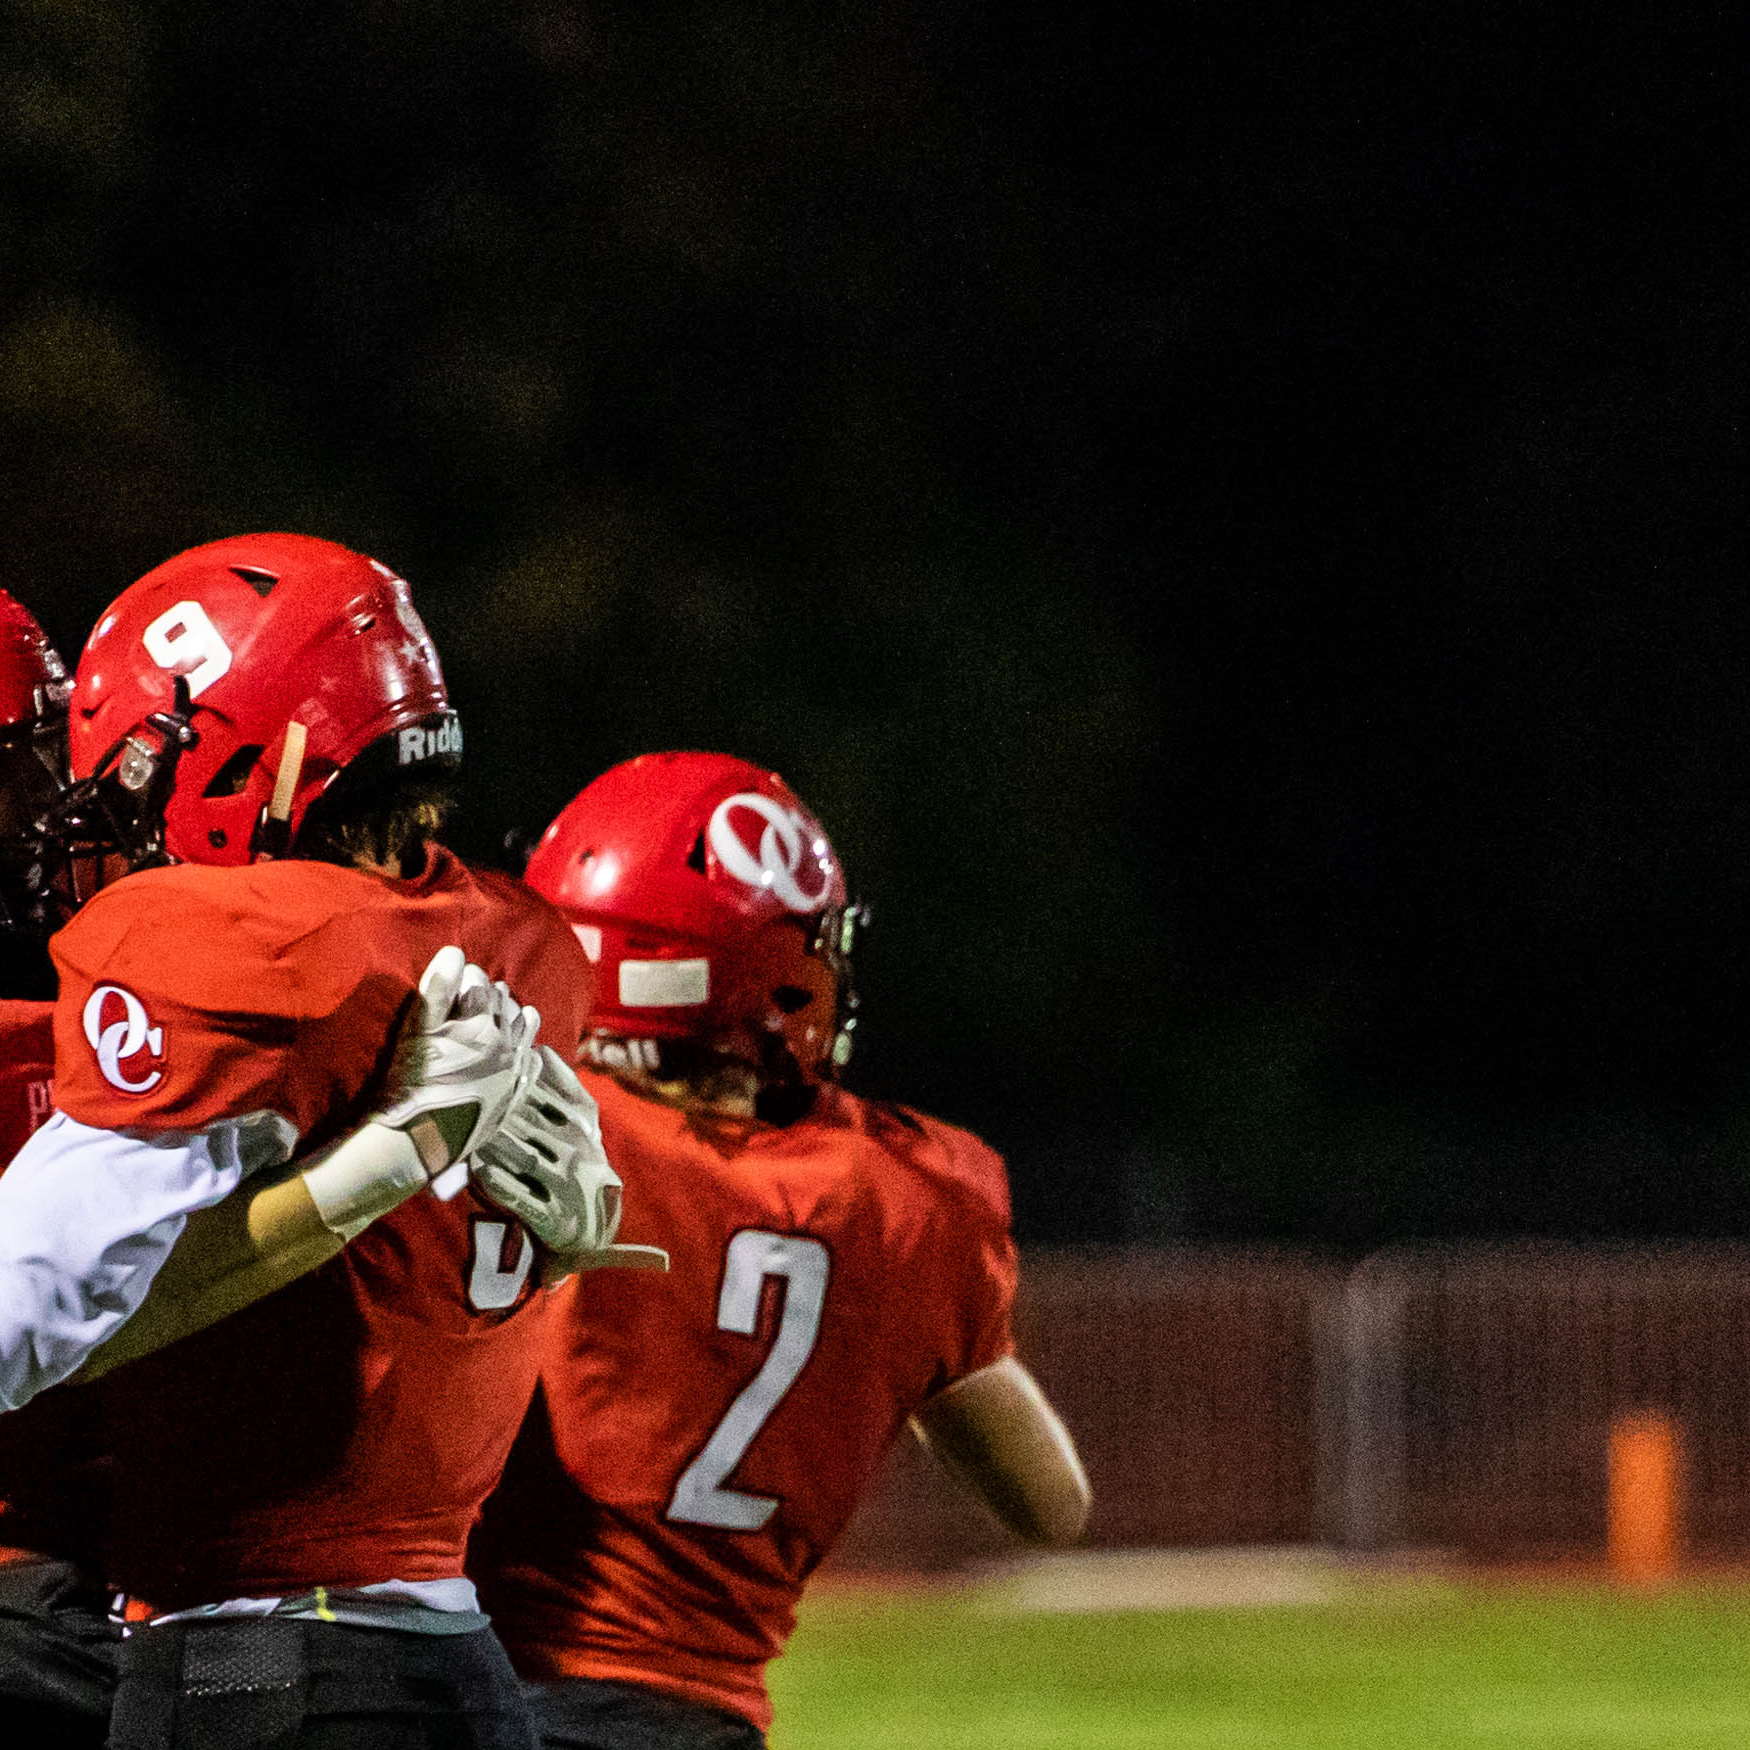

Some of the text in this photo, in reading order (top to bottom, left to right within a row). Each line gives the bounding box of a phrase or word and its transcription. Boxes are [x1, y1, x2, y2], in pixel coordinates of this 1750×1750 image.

[142, 600, 233, 699] 9
[83, 986, 163, 1093] OC
[666, 1229, 831, 1530] 2
